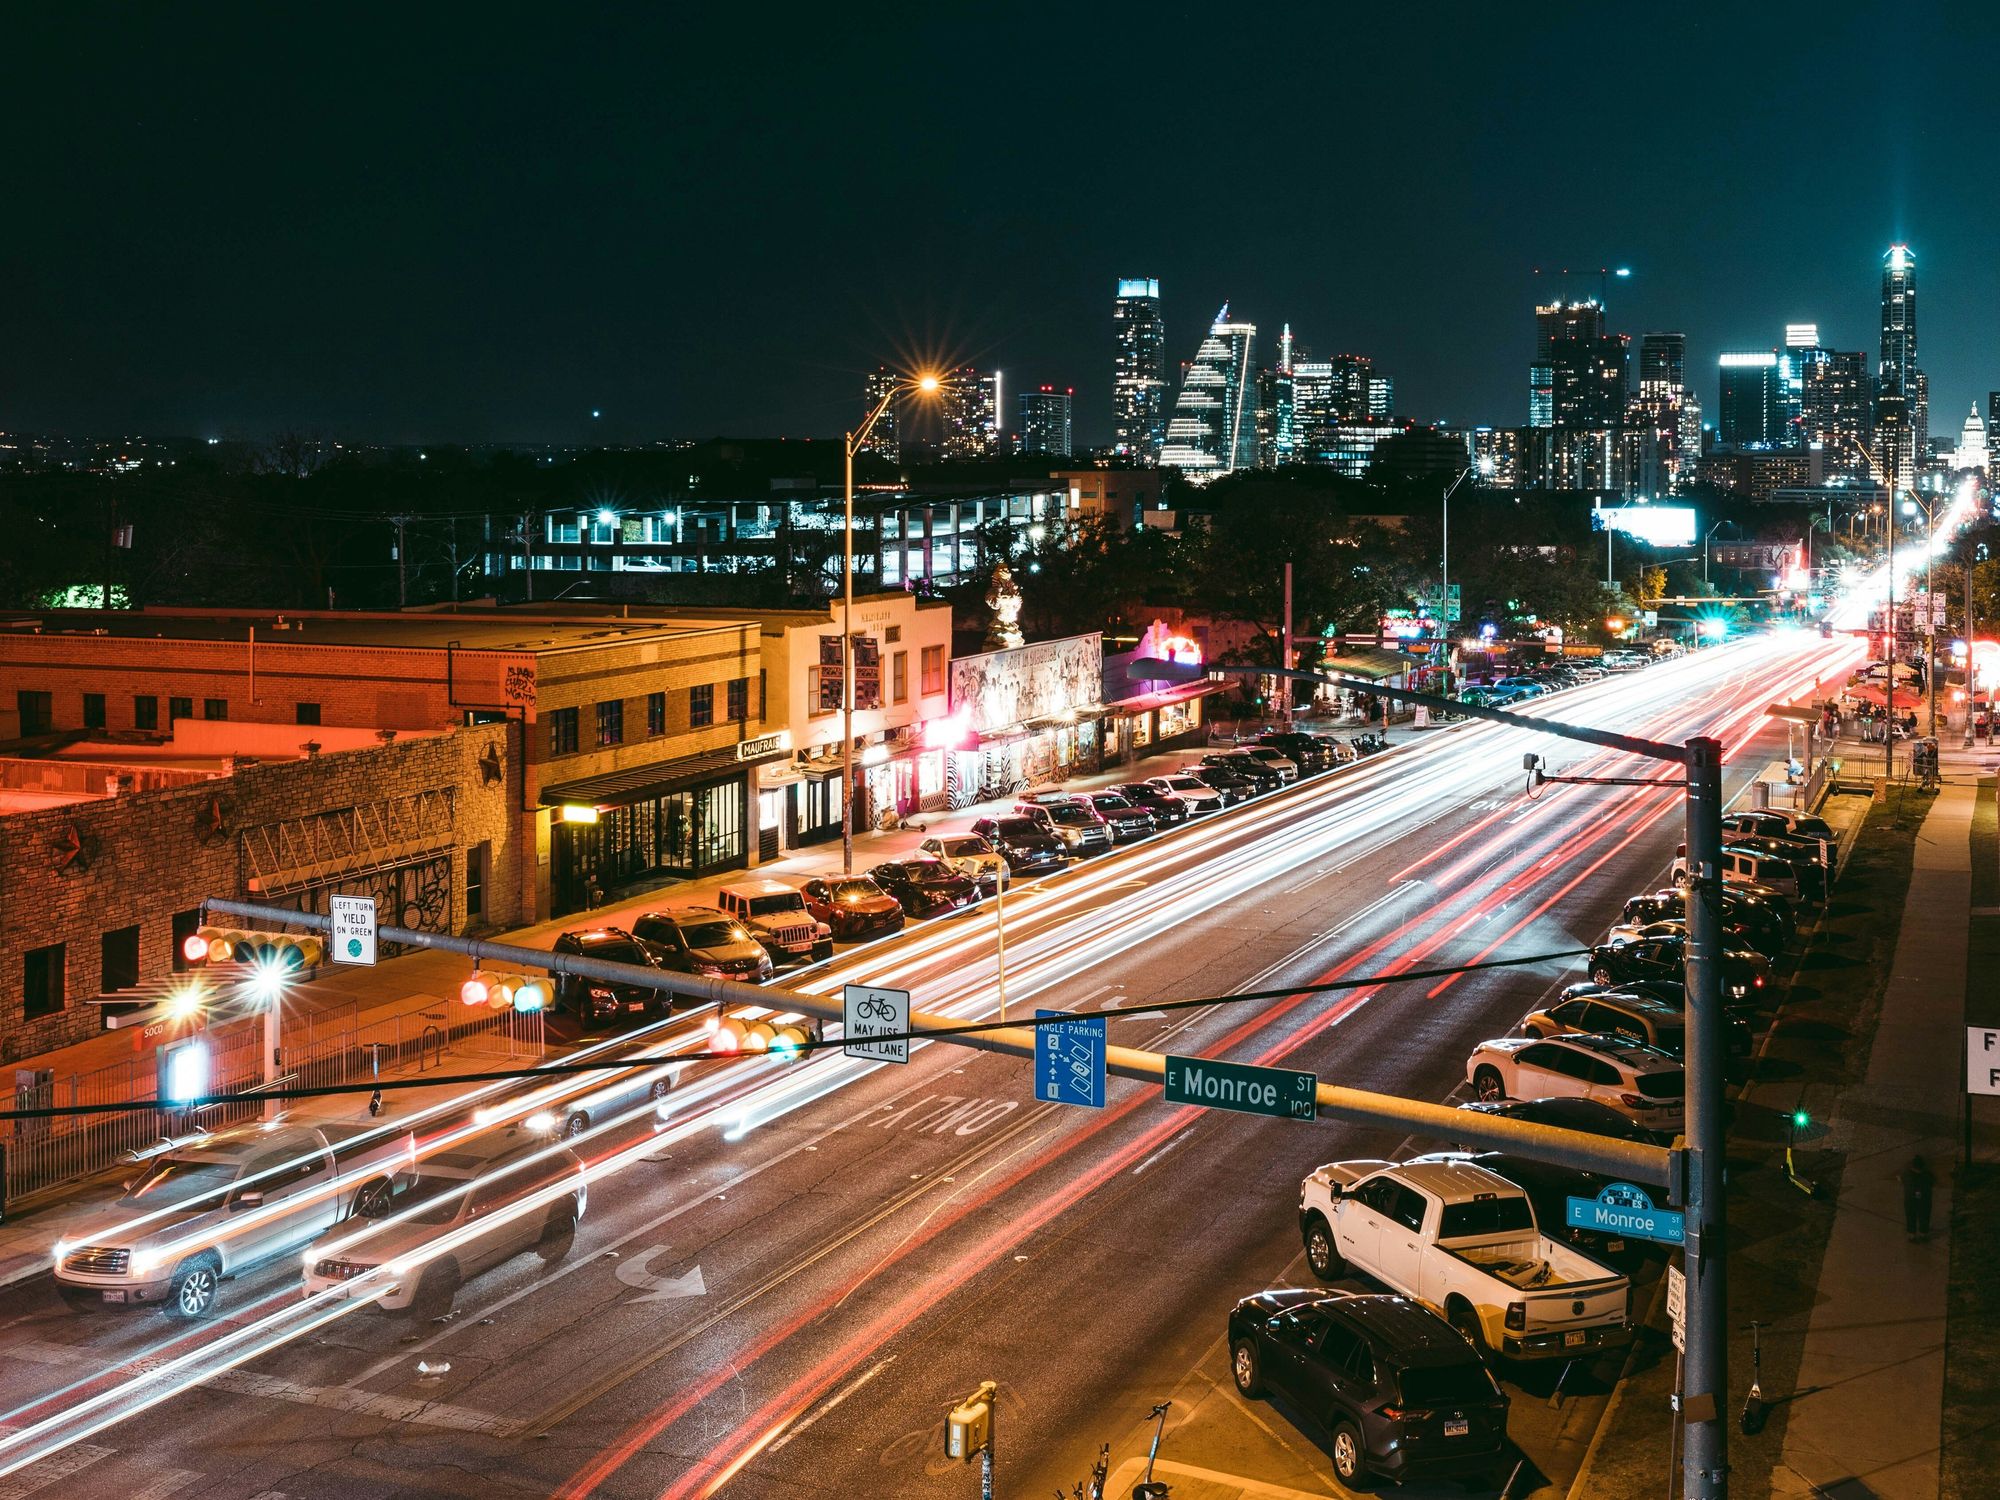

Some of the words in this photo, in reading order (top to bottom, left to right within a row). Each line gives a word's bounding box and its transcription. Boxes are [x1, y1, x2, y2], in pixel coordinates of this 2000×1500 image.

[334, 901, 351, 910] LEFT
[355, 902, 373, 911] TURN
[343, 913, 366, 924] YIELD
[337, 925, 346, 934] ON
[351, 927, 372, 936] GREEN
[144, 1024, 163, 1038] SOCO
[854, 1023, 874, 1036] MAY
[1038, 1023, 1064, 1034] ANGLE
[1068, 1025, 1103, 1038] PARKING
[1050, 1037, 1056, 1046] 2
[879, 1043, 903, 1057] LANE
[1168, 1072, 1176, 1086] E
[1184, 1067, 1277, 1107] Monroe
[1297, 1076, 1313, 1092] ST
[867, 1094, 1019, 1136] ONLY
[1290, 1100, 1312, 1117] 100
[1608, 1189, 1643, 1201] SOUTH
[1575, 1207, 1582, 1217] E
[1595, 1208, 1655, 1231] Monroe
[1671, 1216, 1680, 1224] ST
[1668, 1229, 1680, 1237] 100
